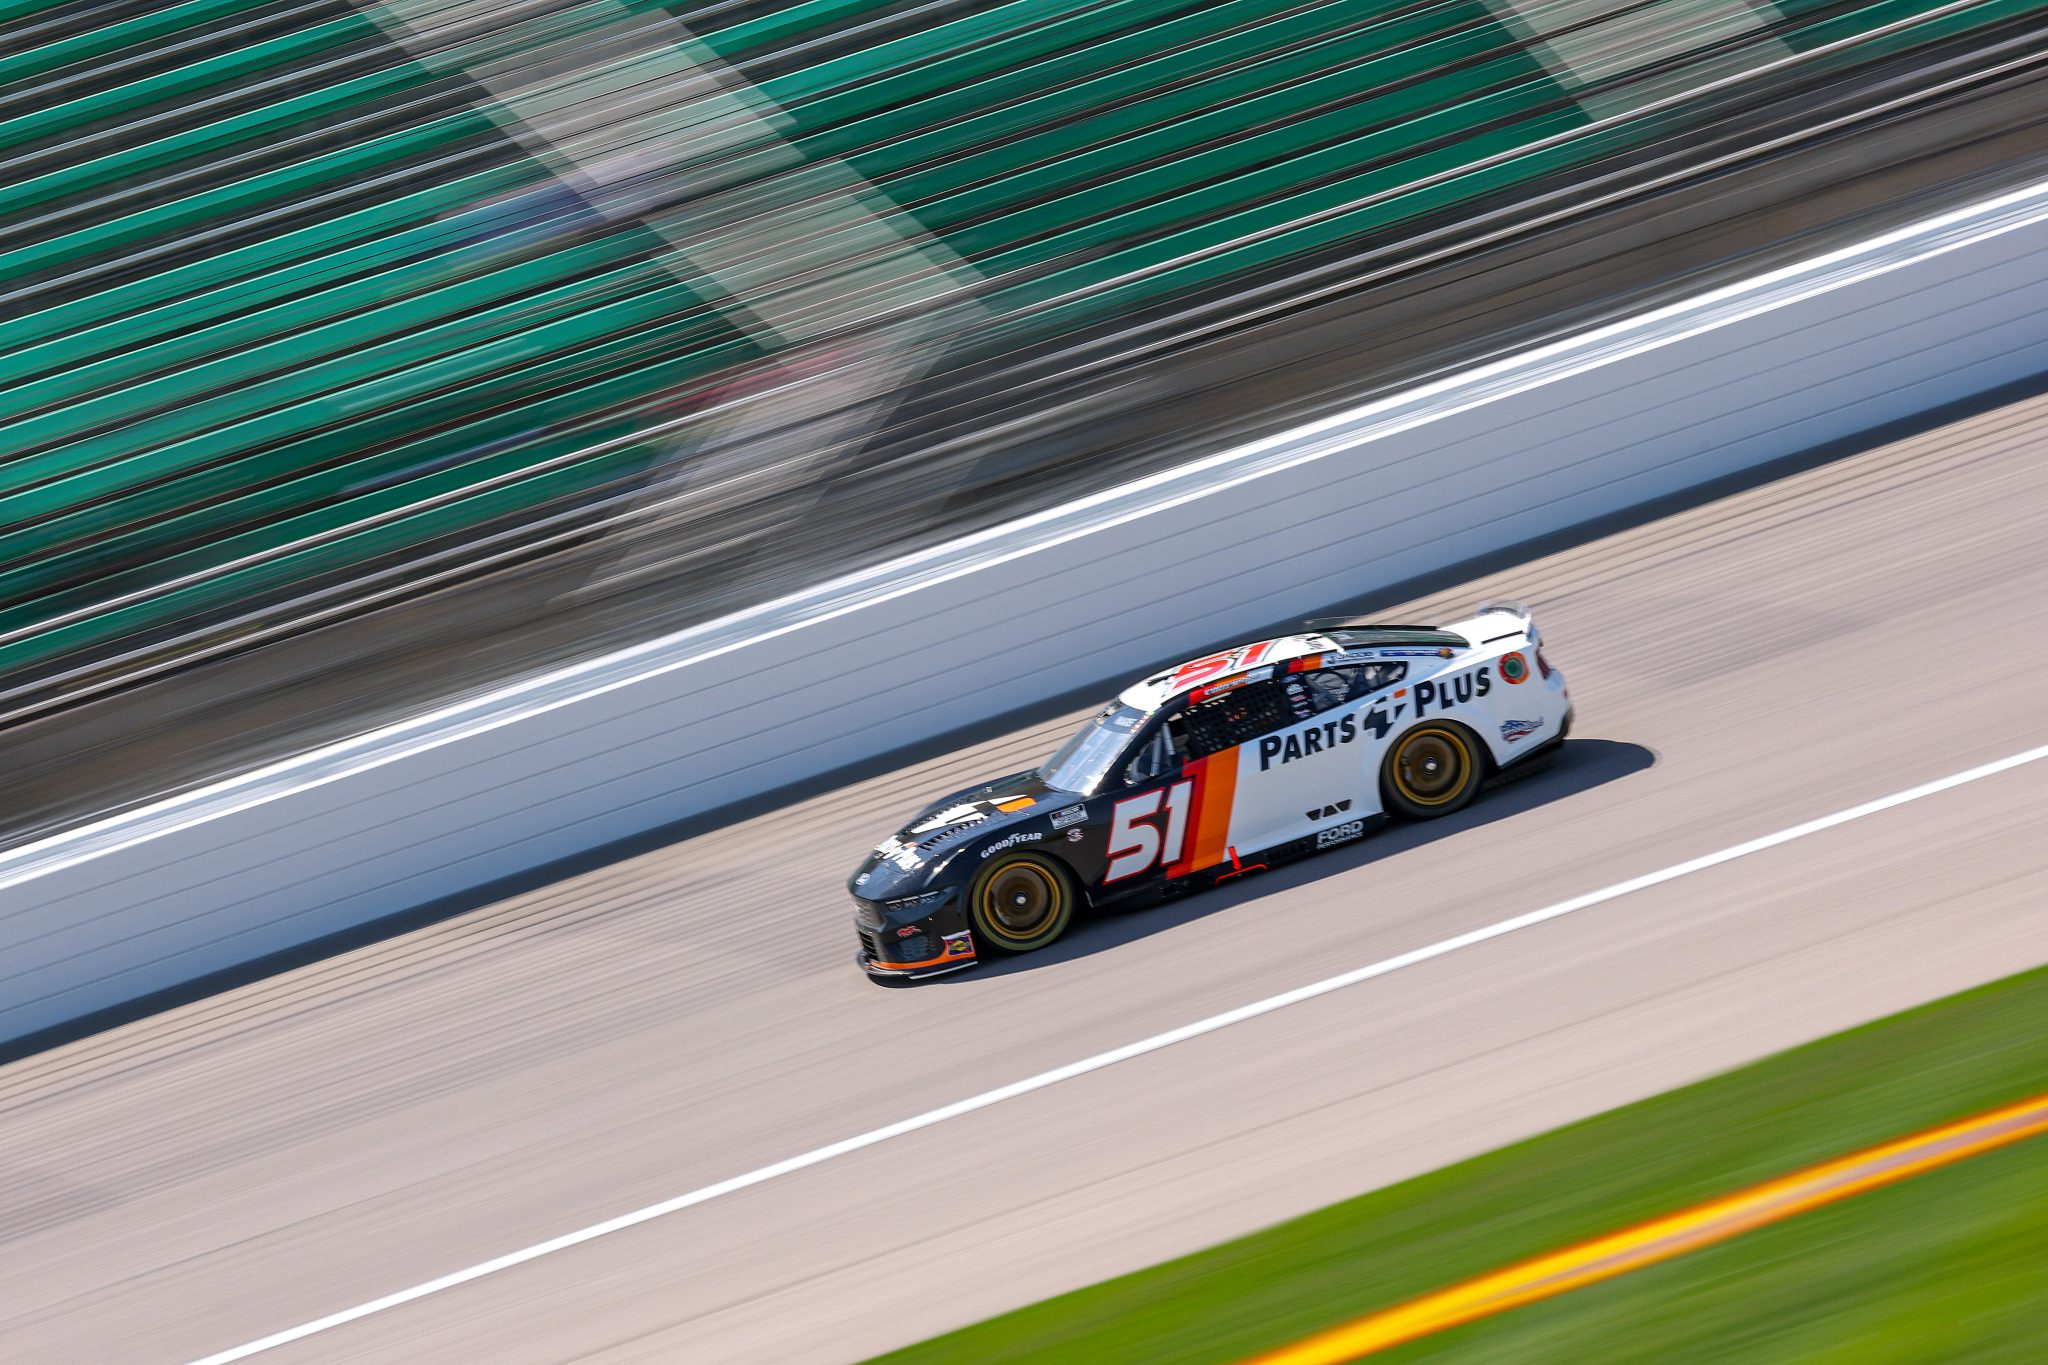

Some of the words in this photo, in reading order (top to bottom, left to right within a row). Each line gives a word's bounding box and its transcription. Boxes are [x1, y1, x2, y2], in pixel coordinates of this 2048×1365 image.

[1259, 713, 1356, 771] PARTS
[1414, 666, 1491, 718] PLUS
[980, 832, 1043, 859] GOODYEAR
[1103, 776, 1196, 886] 51
[1316, 820, 1364, 844] FORD
